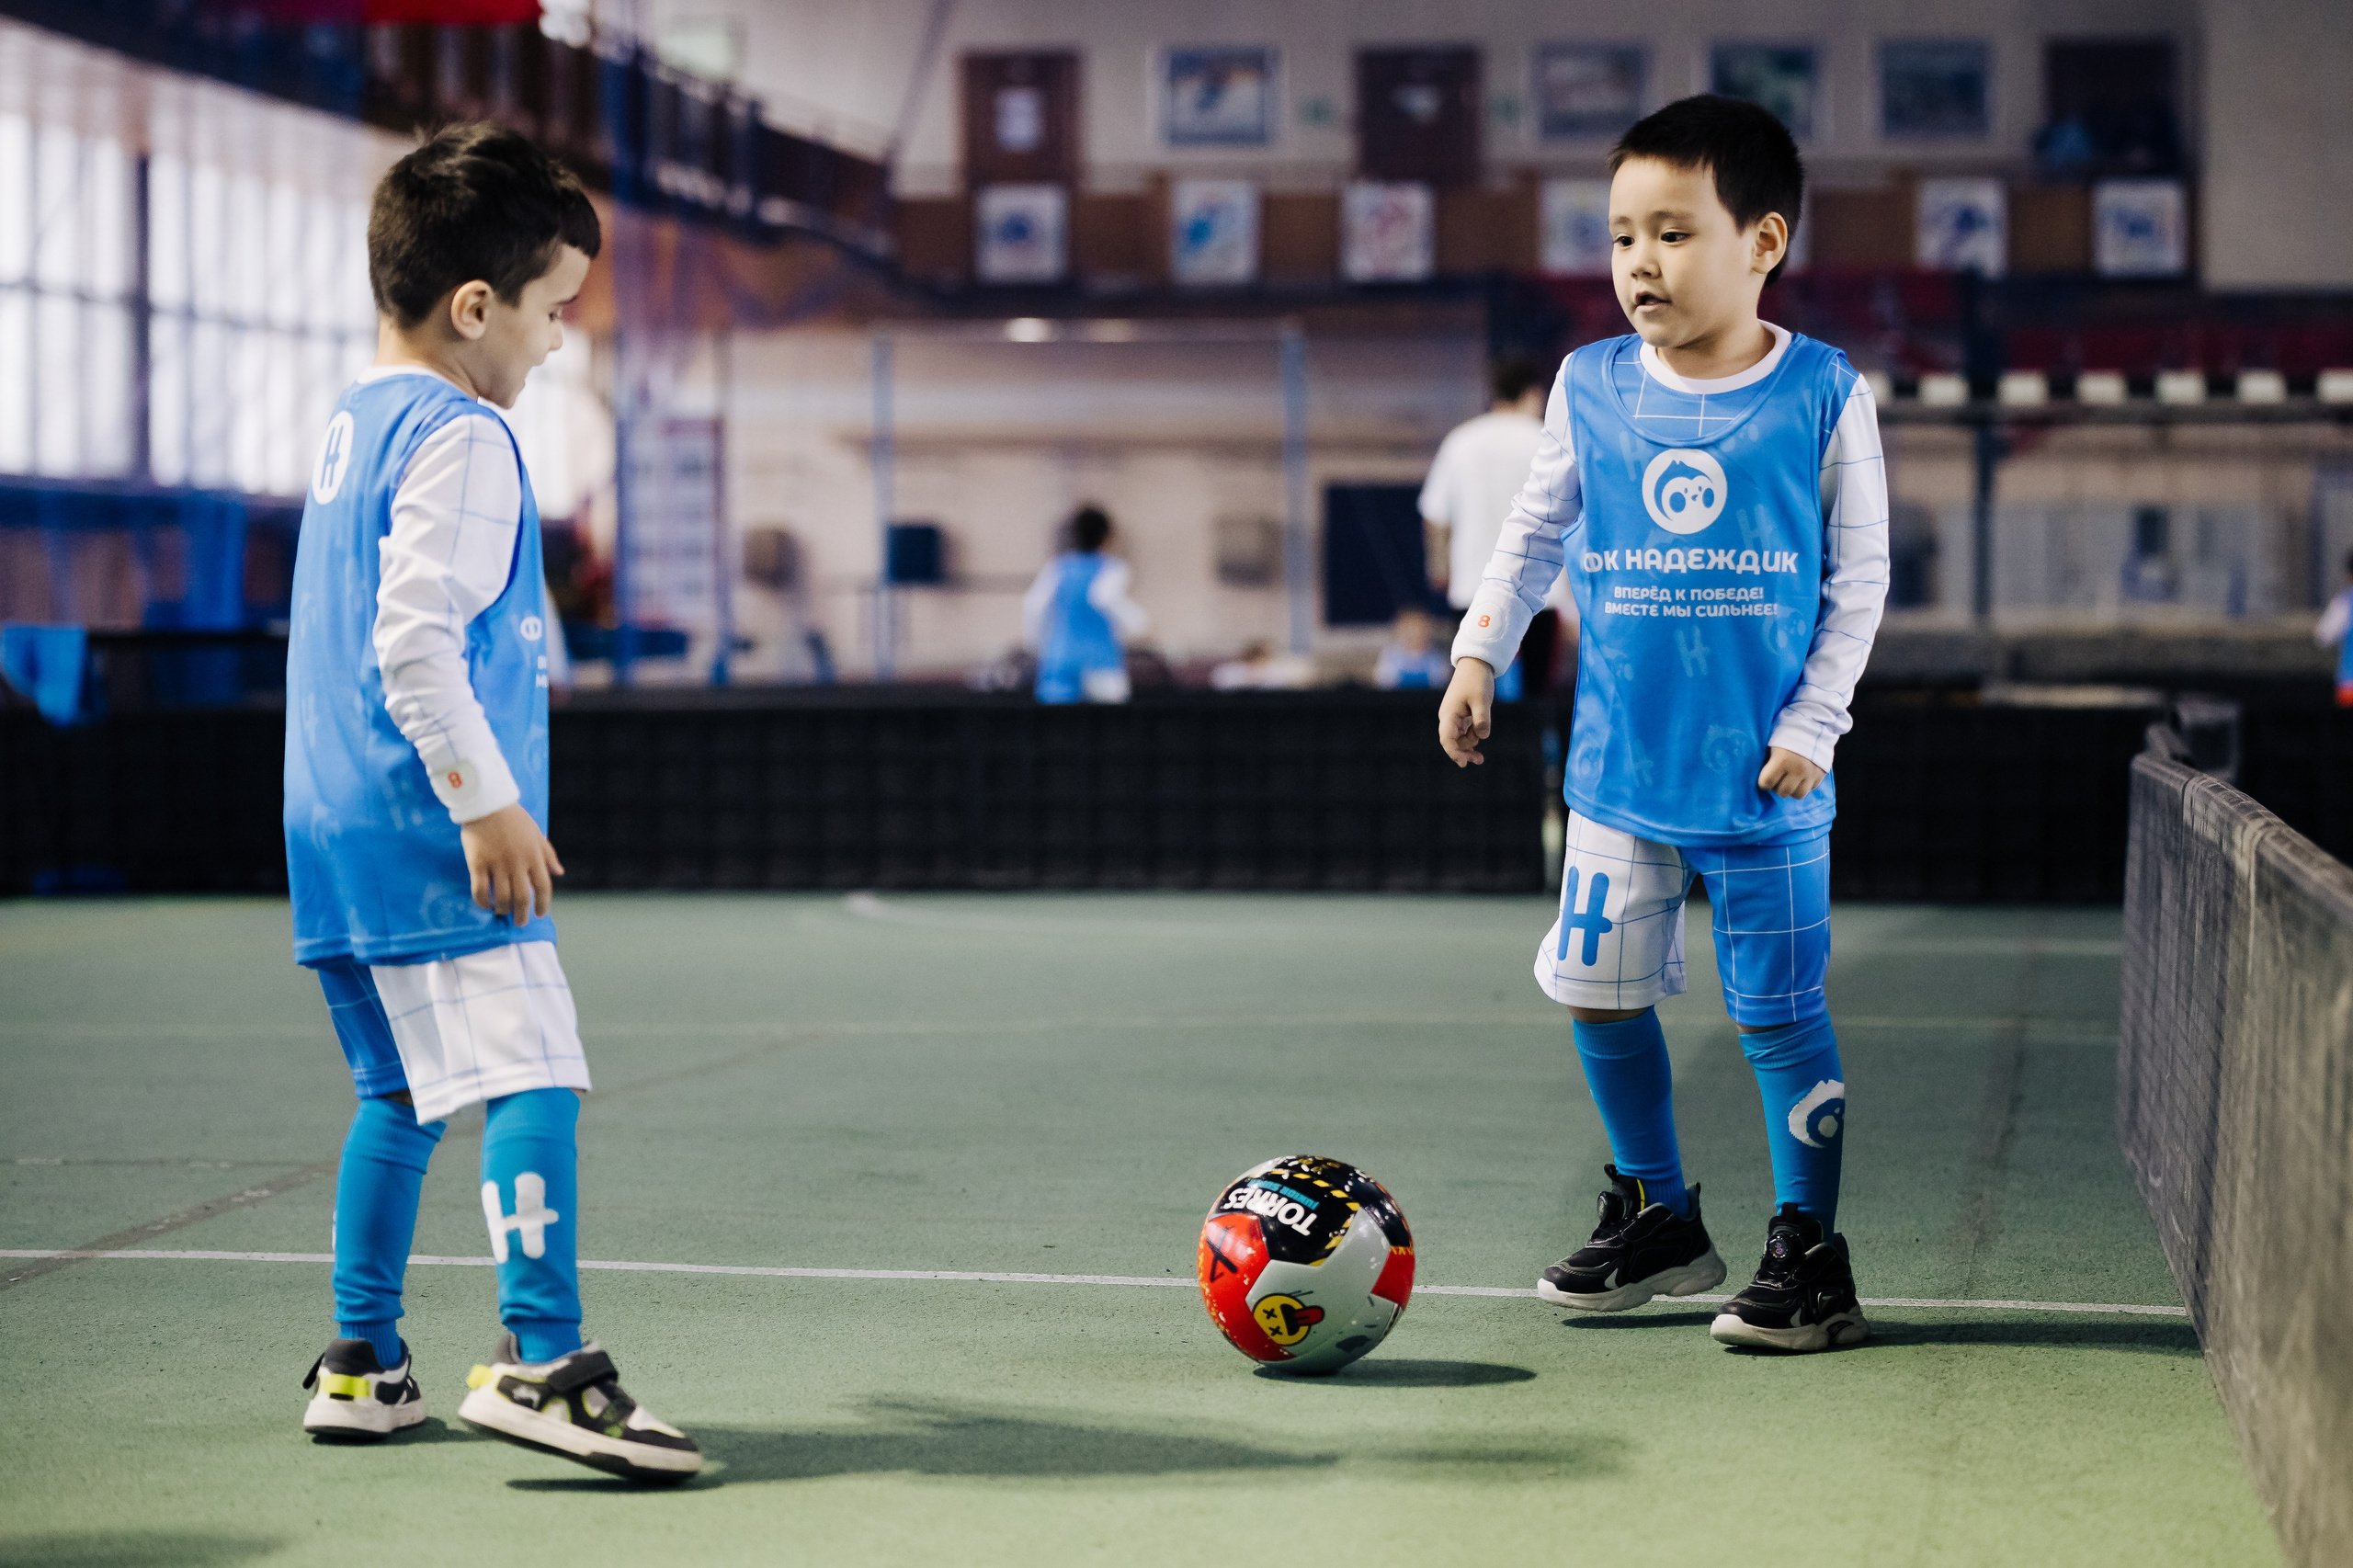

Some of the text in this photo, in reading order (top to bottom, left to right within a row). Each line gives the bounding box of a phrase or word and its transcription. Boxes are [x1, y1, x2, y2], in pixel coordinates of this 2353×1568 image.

[1584, 548, 1799, 575] ФК НАДЕЖДИК
[1614, 585, 1765, 603] ВПЕРЁД К ПОБЕДЕ!
[1604, 601, 1779, 618] ВМЕСТЕ МЫ СИЛЬНЕЕ!
[1223, 1187, 1317, 1236] TORRES
